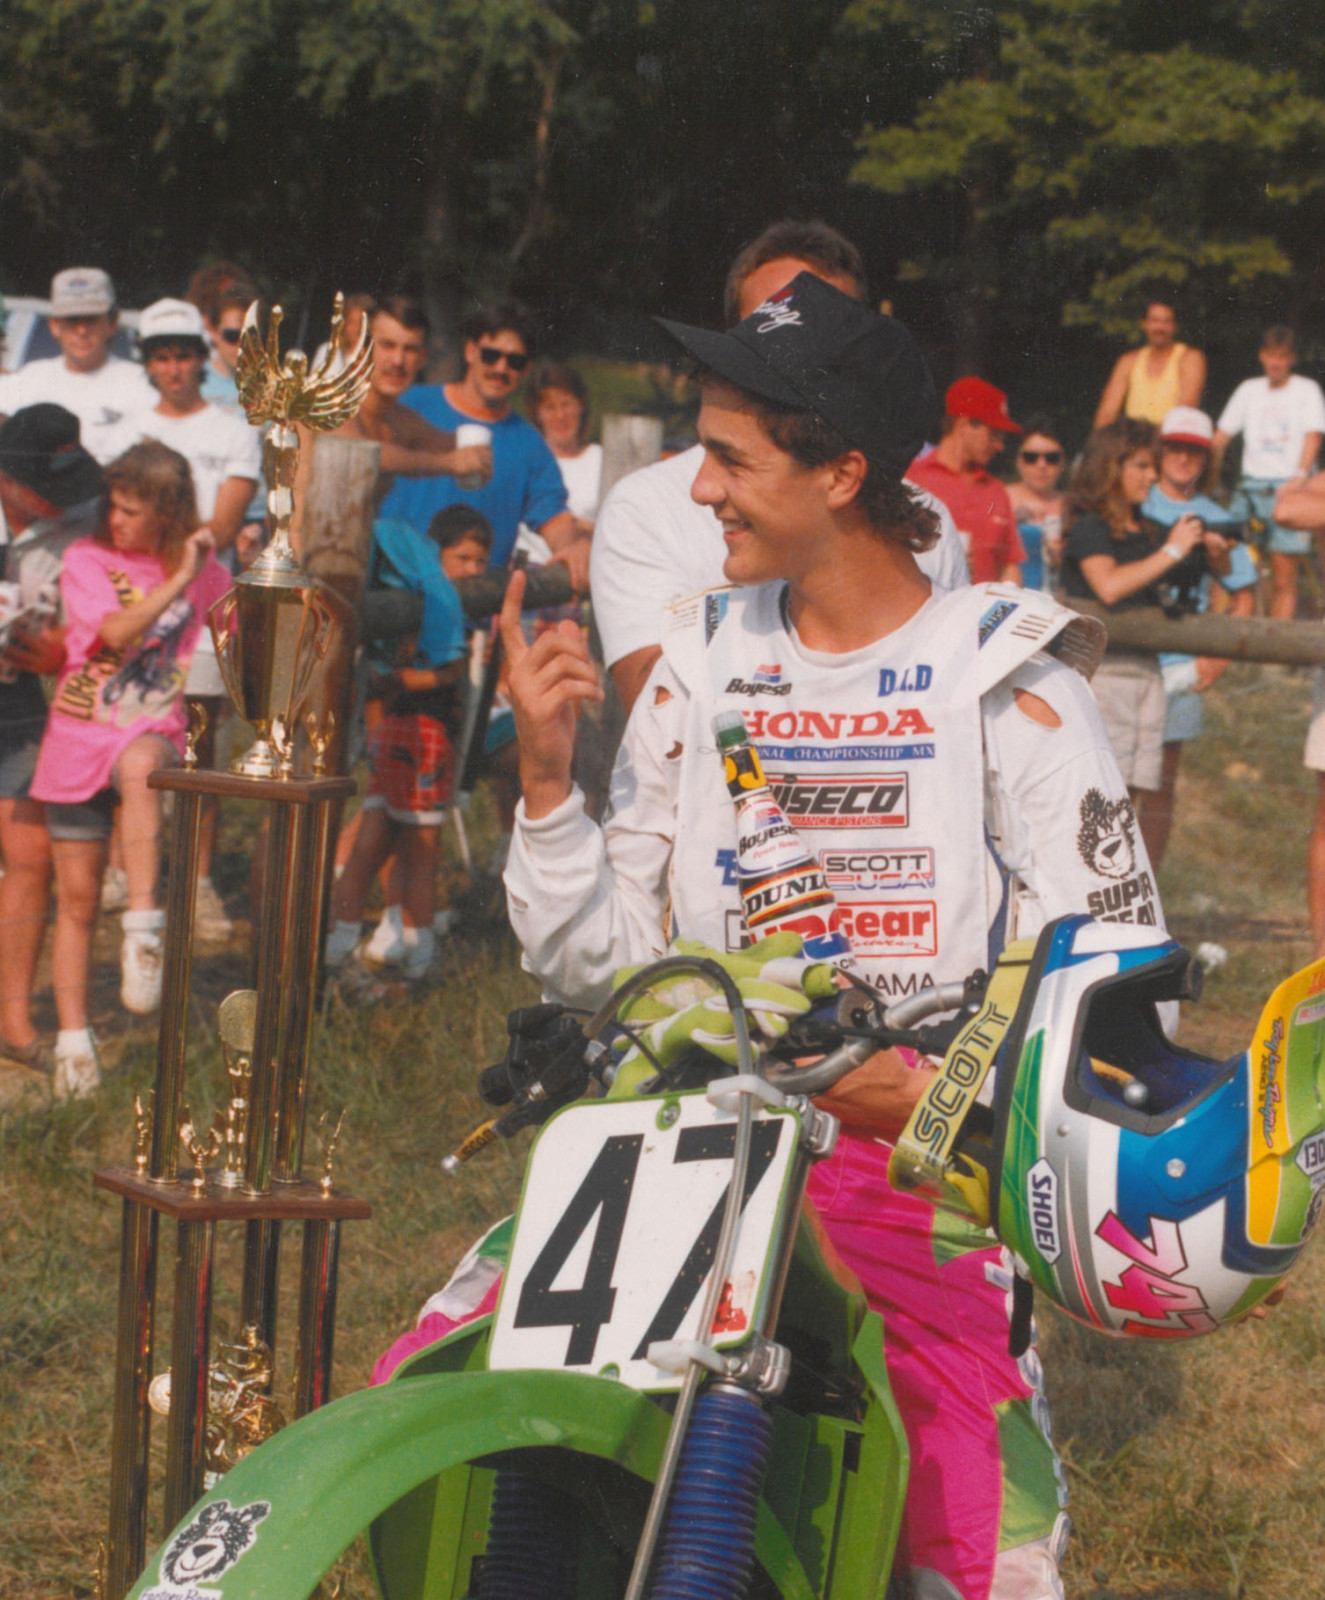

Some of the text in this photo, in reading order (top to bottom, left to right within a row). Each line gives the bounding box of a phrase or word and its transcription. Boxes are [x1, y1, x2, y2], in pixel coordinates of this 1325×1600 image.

[742, 707, 935, 740] HONDA
[793, 746, 903, 760] CHAMPIONSHIP
[912, 744, 934, 757] MX
[826, 854, 928, 873] SCOTT
[865, 972, 936, 996] AMA
[914, 1002, 1010, 1164] SCOTT
[1032, 1173, 1057, 1252] SHOEI
[513, 1118, 784, 1366] 47
